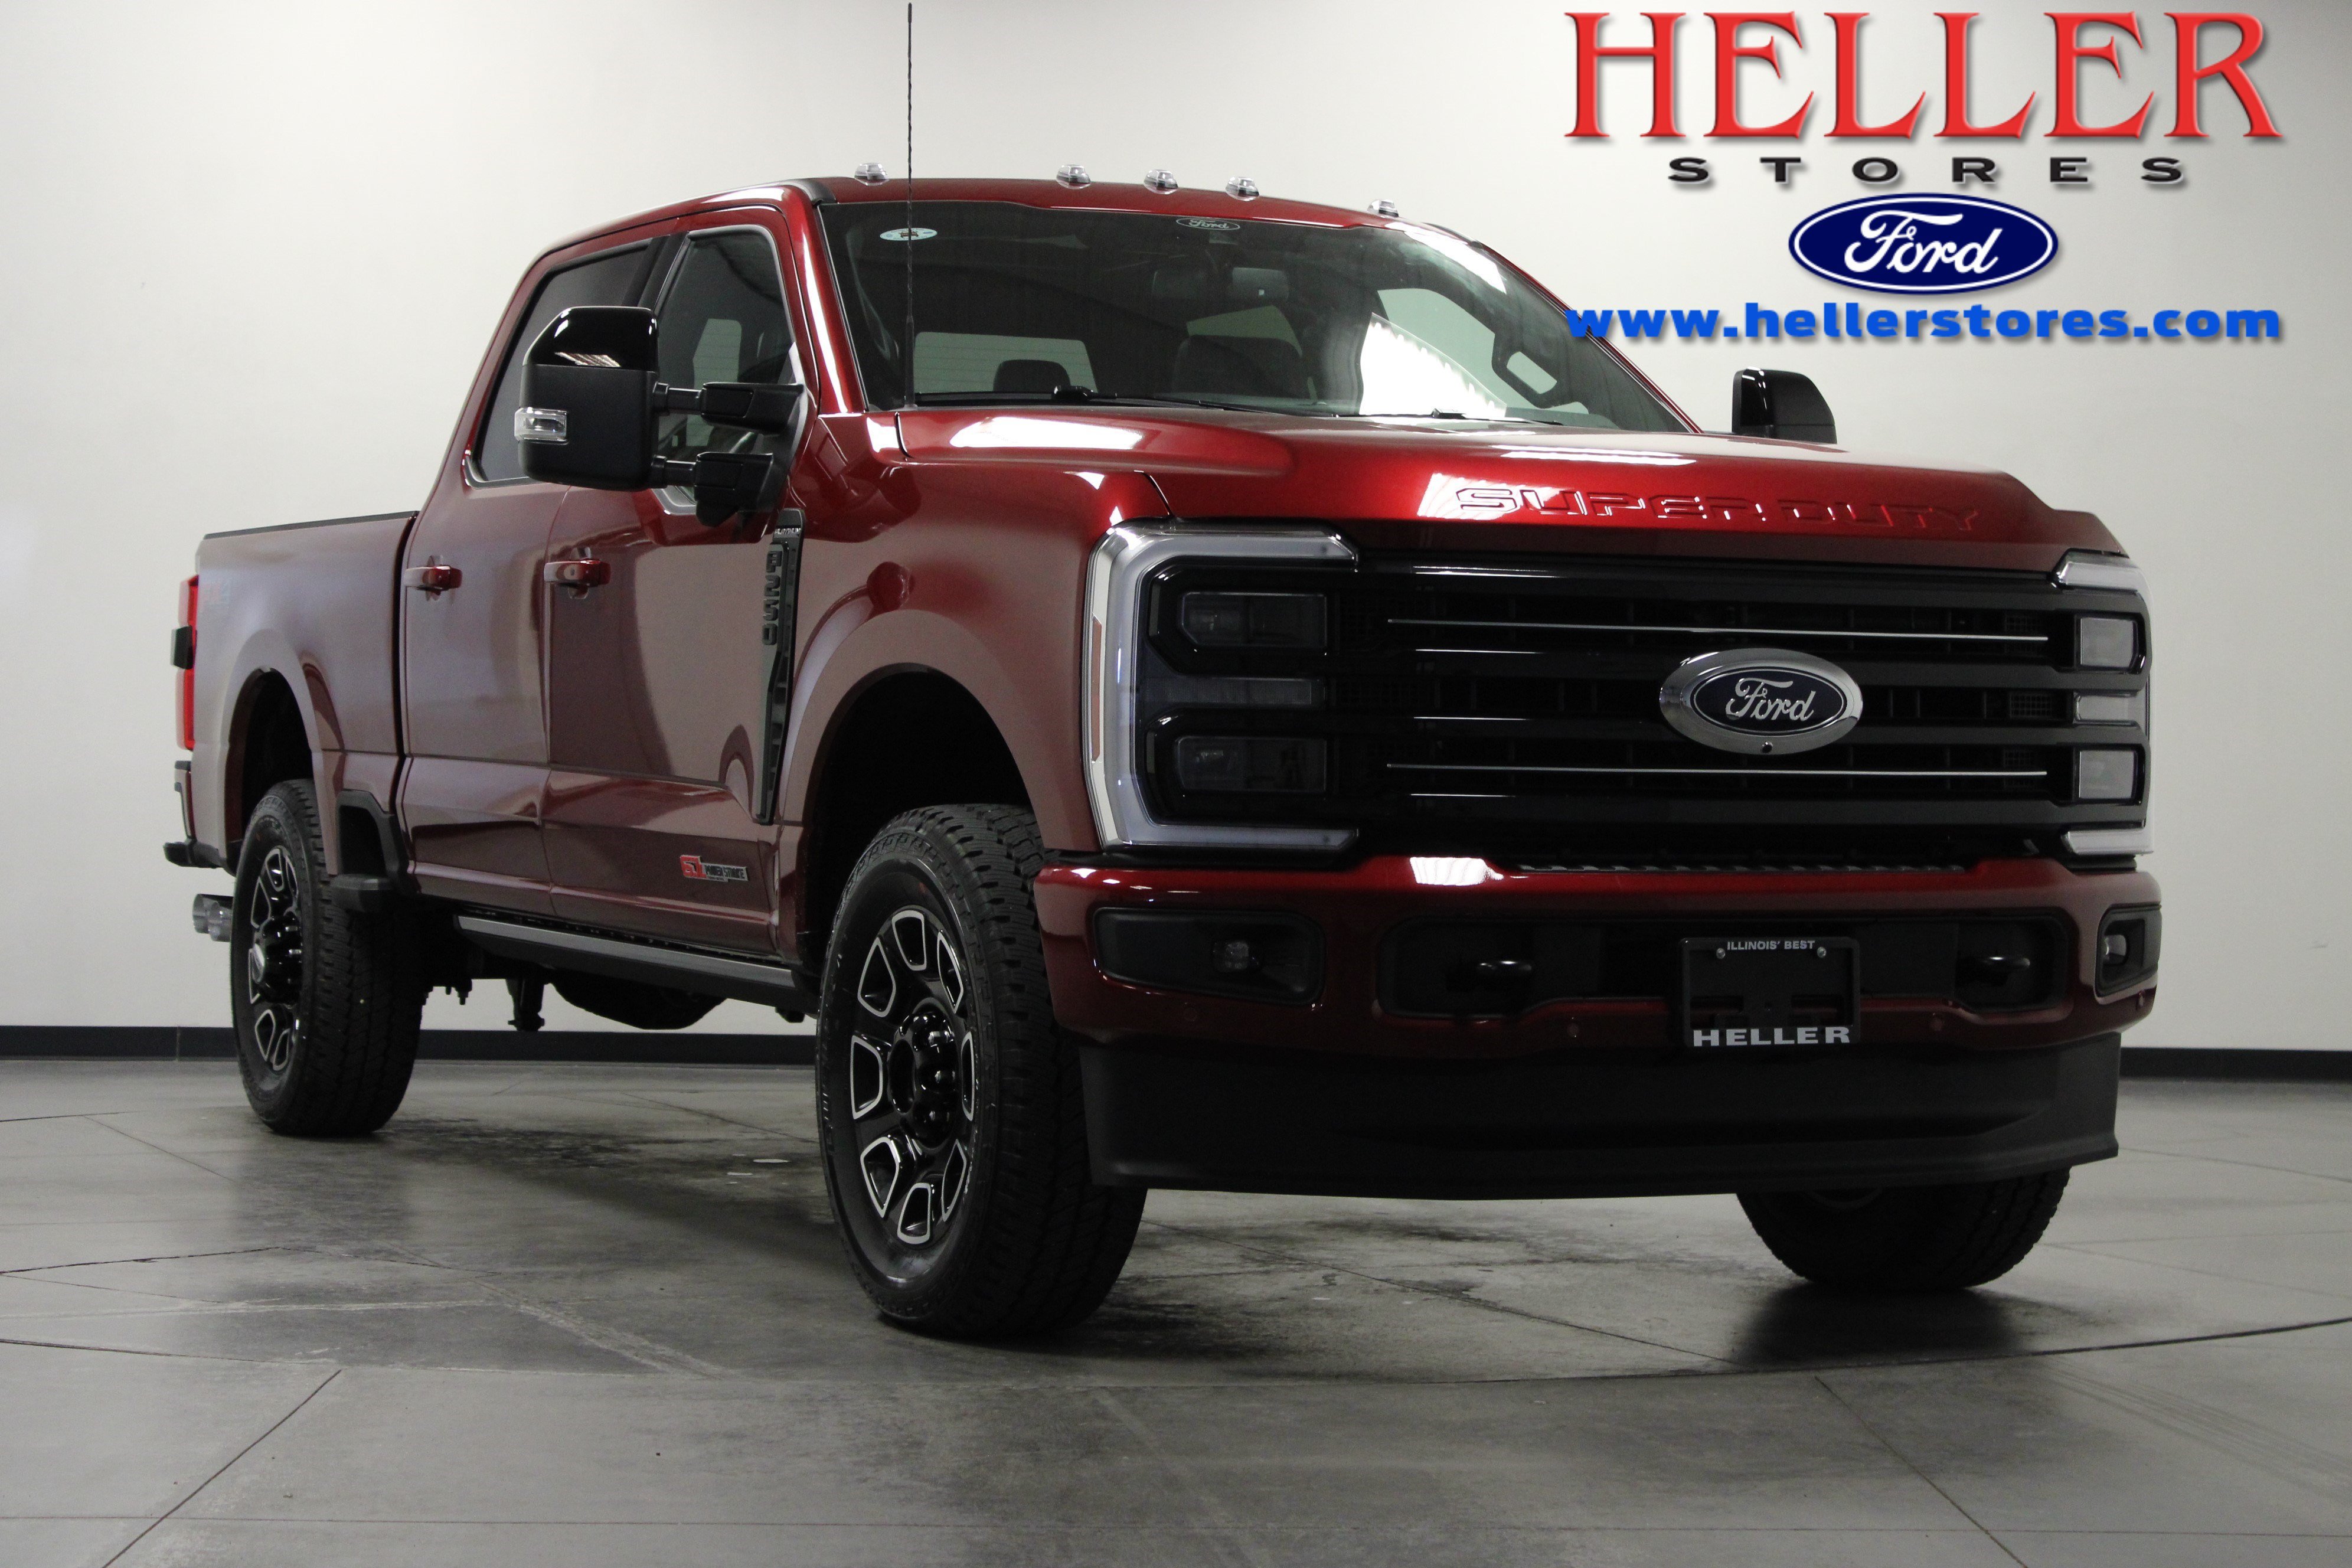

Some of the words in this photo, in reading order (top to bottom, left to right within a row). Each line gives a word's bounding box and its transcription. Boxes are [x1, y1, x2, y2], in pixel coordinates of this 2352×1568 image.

[1188, 219, 1229, 229] Ford
[1455, 487, 1764, 522] SUPER
[1776, 498, 1979, 530] DUTY
[1725, 677, 1816, 721] Ford
[1727, 940, 1781, 950] ILLINOIS'
[1784, 940, 1815, 949] BEST
[1693, 1027, 1850, 1047] HELLER
